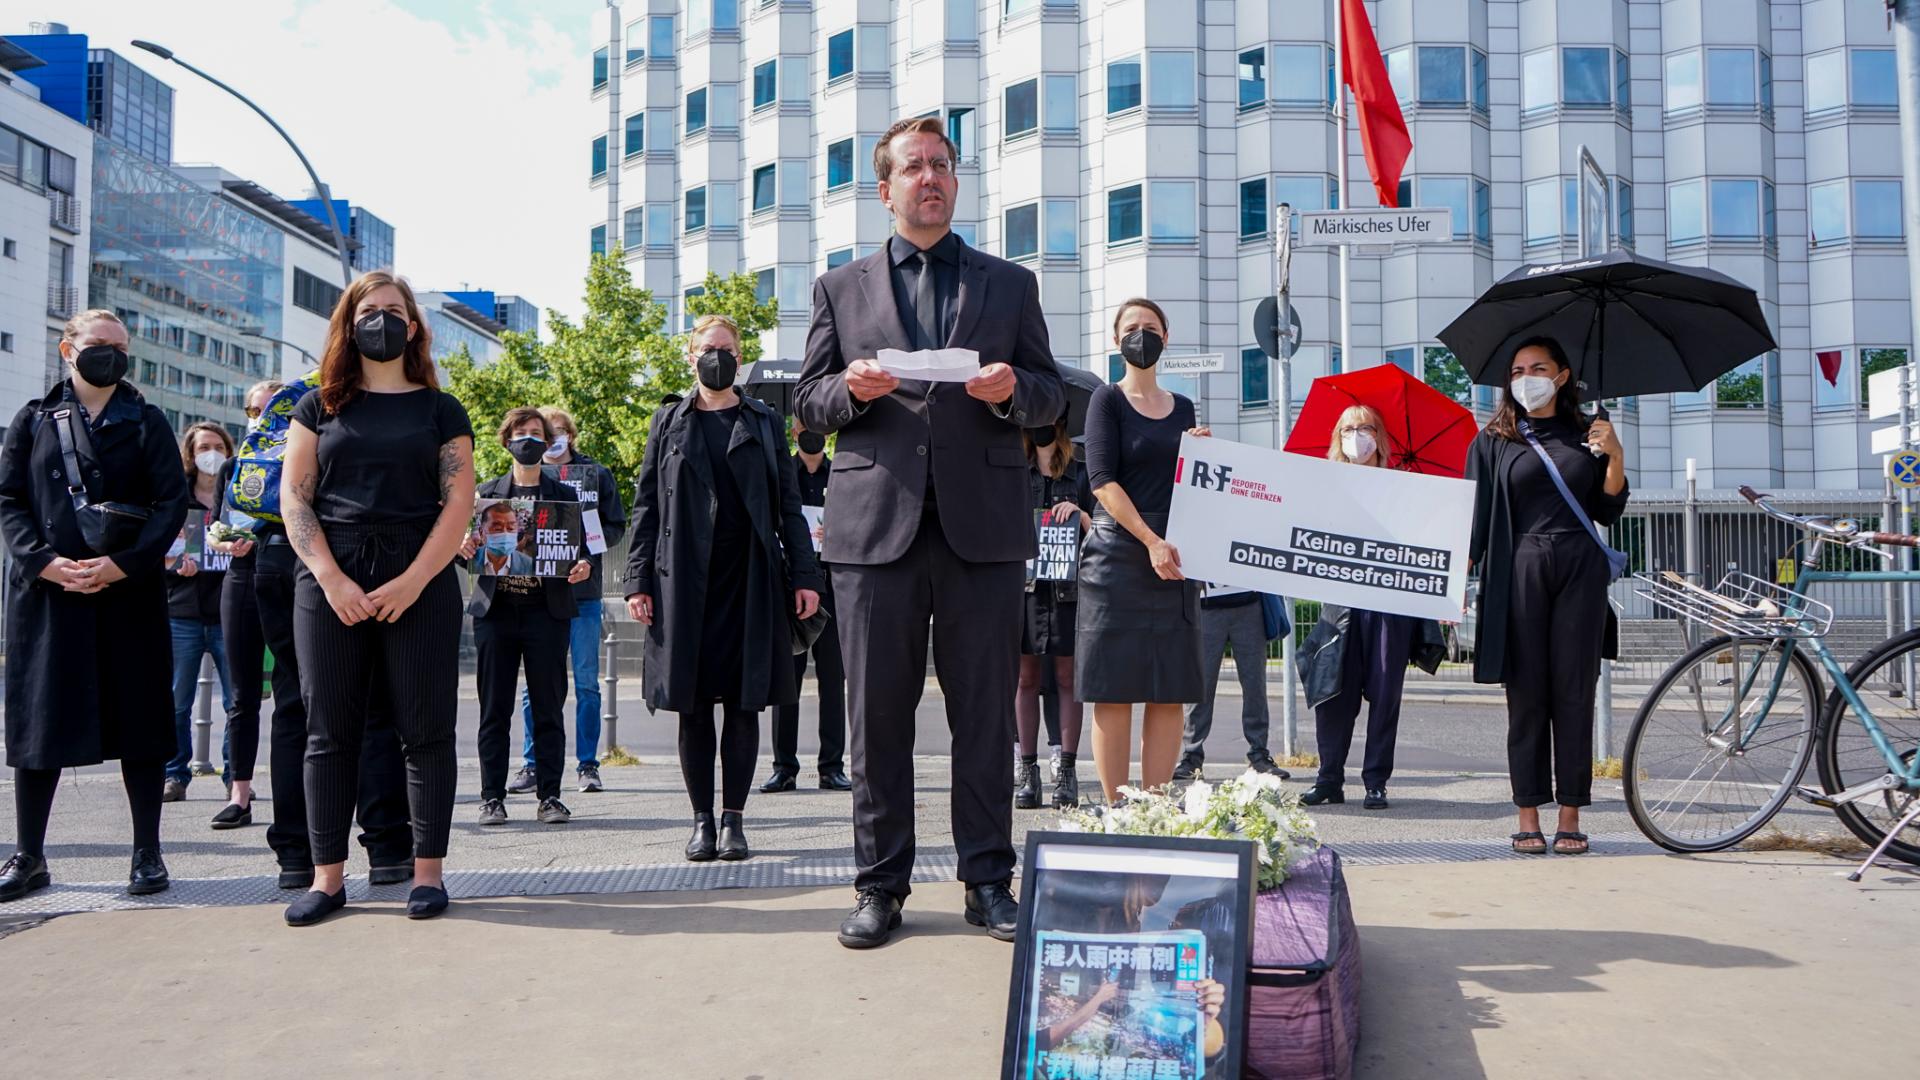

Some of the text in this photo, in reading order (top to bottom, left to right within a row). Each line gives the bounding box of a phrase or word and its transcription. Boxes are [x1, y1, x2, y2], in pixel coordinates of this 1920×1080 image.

[1313, 215, 1431, 235] Märkisches Ufer
[1164, 359, 1217, 369] Märkisches Ufer
[1191, 460, 1233, 492] RSF
[1231, 478, 1267, 492] REPORTER
[577, 491, 598, 502] UNG
[1230, 487, 1282, 503] OHNE GRENZEN
[536, 529, 568, 544] FREE
[1040, 526, 1075, 543] FREE
[536, 545, 579, 560] JIMMY
[1038, 544, 1076, 561] RYAN
[1295, 530, 1447, 570] Keine Freiheit
[204, 555, 232, 570] LAW
[535, 561, 557, 576] LAI
[1036, 561, 1070, 579] LAW
[1234, 547, 1444, 595] ohne Pressefreiheit
